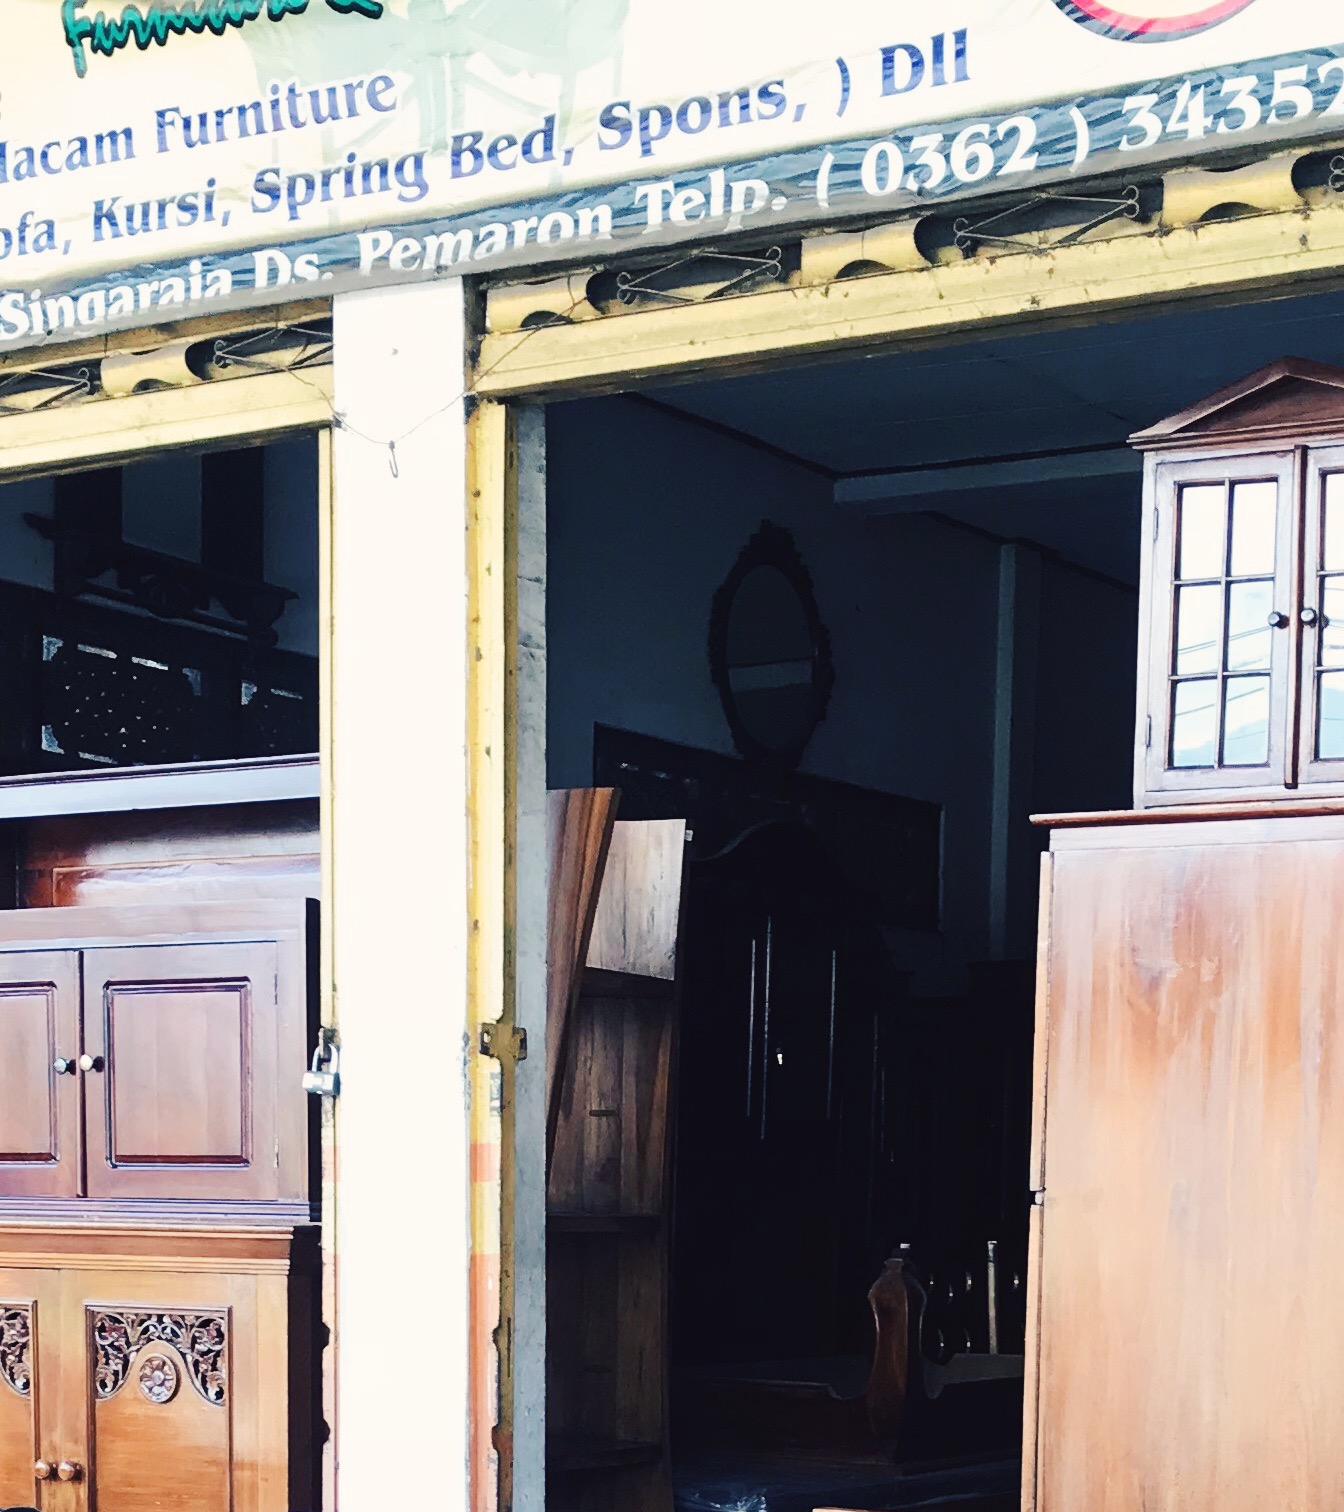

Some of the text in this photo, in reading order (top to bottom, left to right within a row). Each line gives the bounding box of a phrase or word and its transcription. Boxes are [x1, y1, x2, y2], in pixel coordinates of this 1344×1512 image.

[92, 177, 232, 242] Kursi,
[251, 150, 429, 221] Spring
[449, 113, 574, 180] Bed,
[597, 79, 808, 158] Spons,
[154, 74, 397, 153] Furniture
[252, 249, 334, 293] Ds.
[356, 202, 613, 278] Pemaron
[634, 168, 788, 235] Telp.
[861, 116, 1040, 198] 0362
